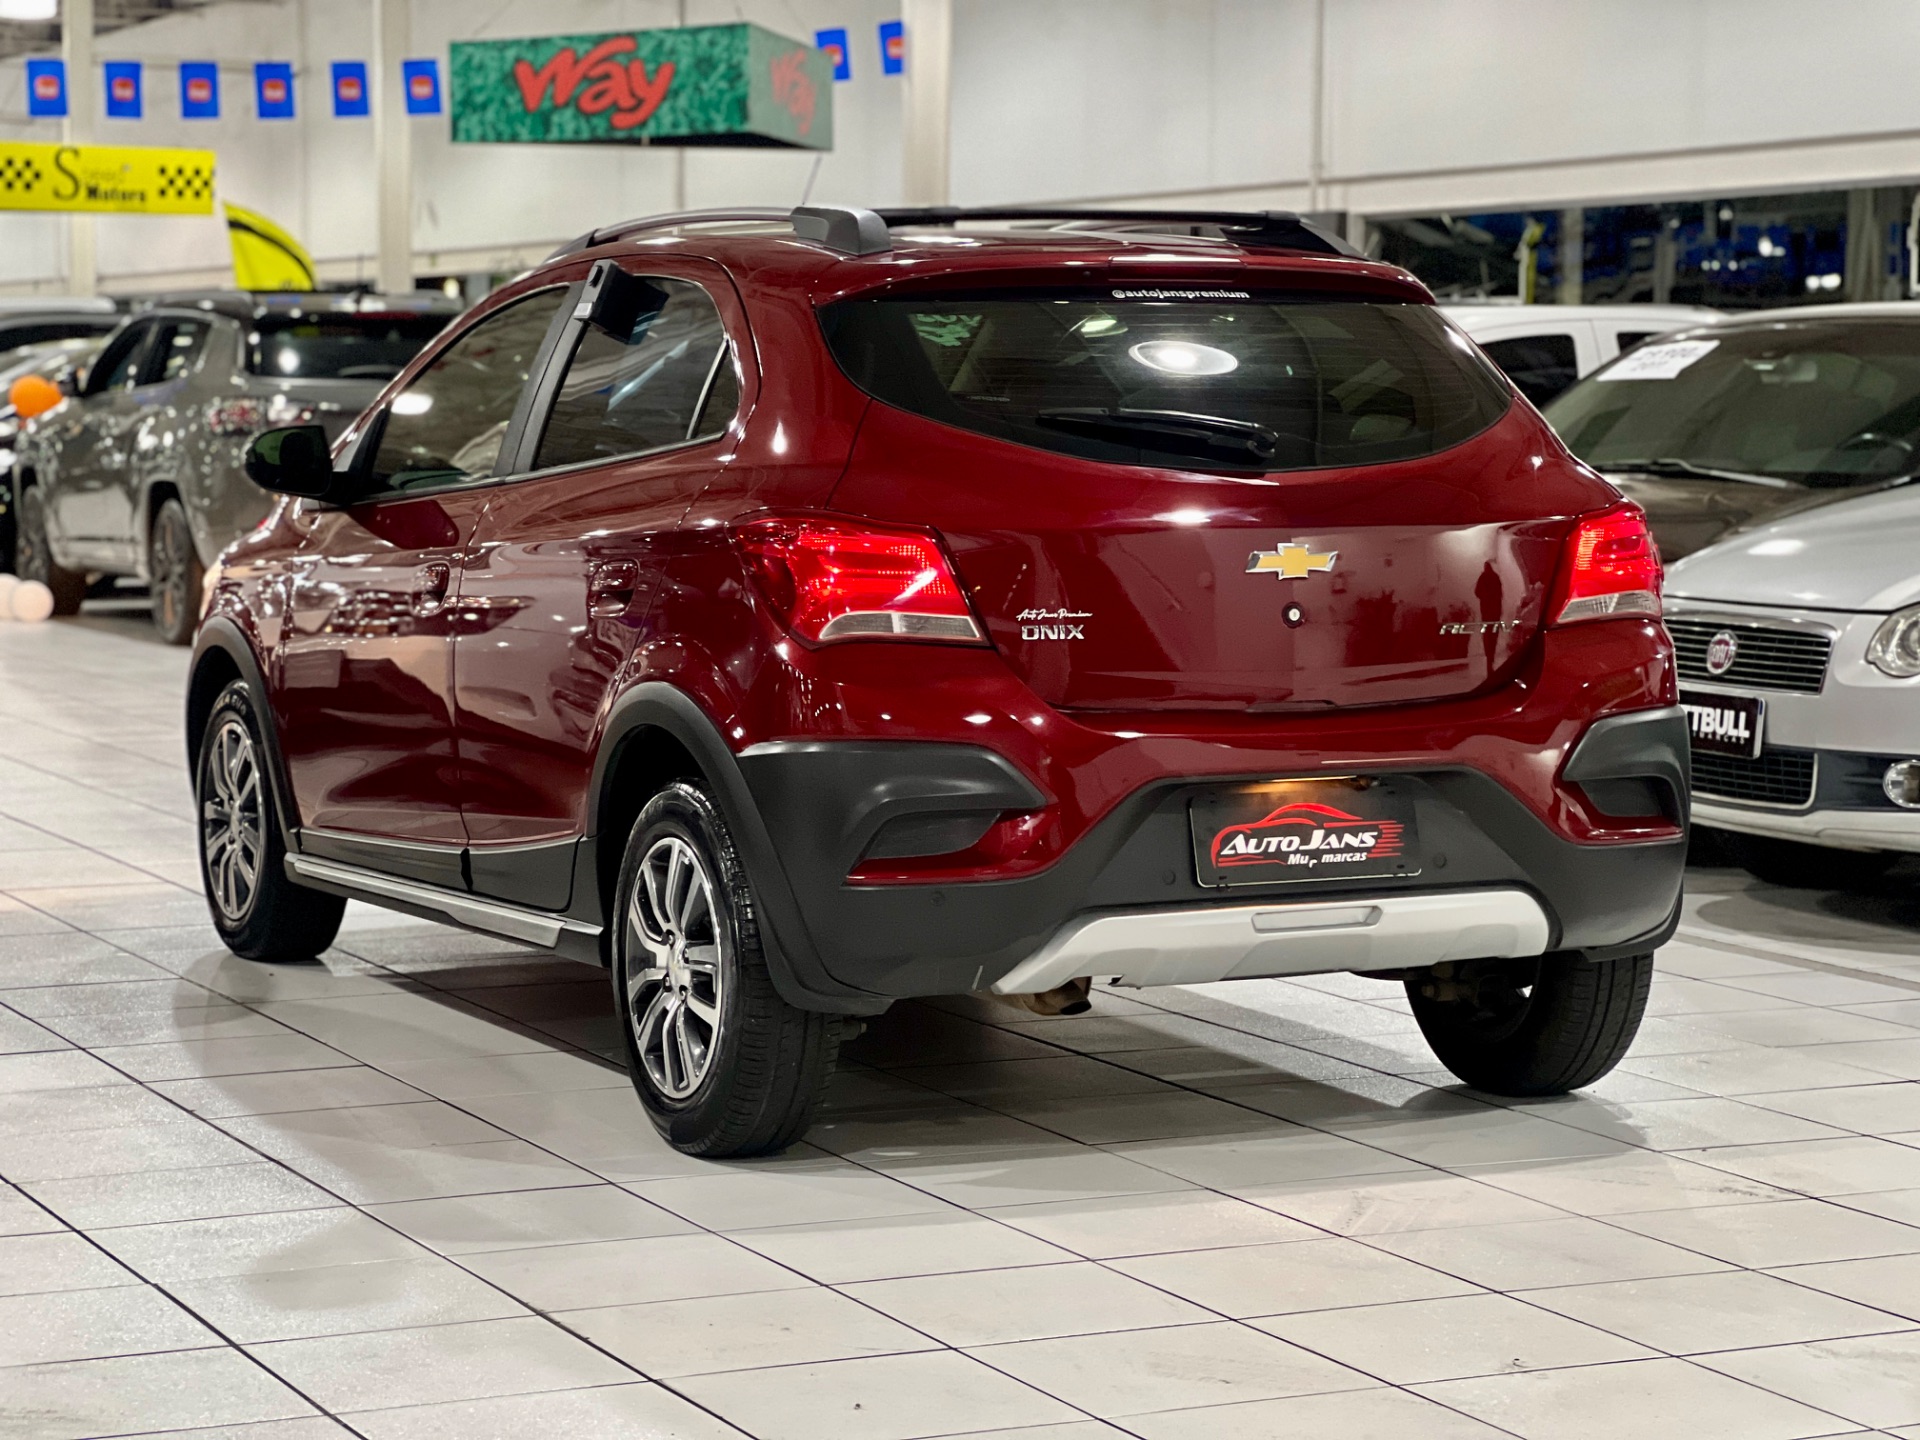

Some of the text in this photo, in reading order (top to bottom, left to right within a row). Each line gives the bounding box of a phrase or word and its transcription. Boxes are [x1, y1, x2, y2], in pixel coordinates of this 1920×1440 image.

[513, 36, 676, 129] Way
[770, 49, 817, 137] Way
[1112, 289, 1250, 299] @autojanspremium
[1021, 624, 1085, 641] ONIX
[1439, 620, 1522, 635] ACTIV
[1321, 851, 1368, 863] marcas
